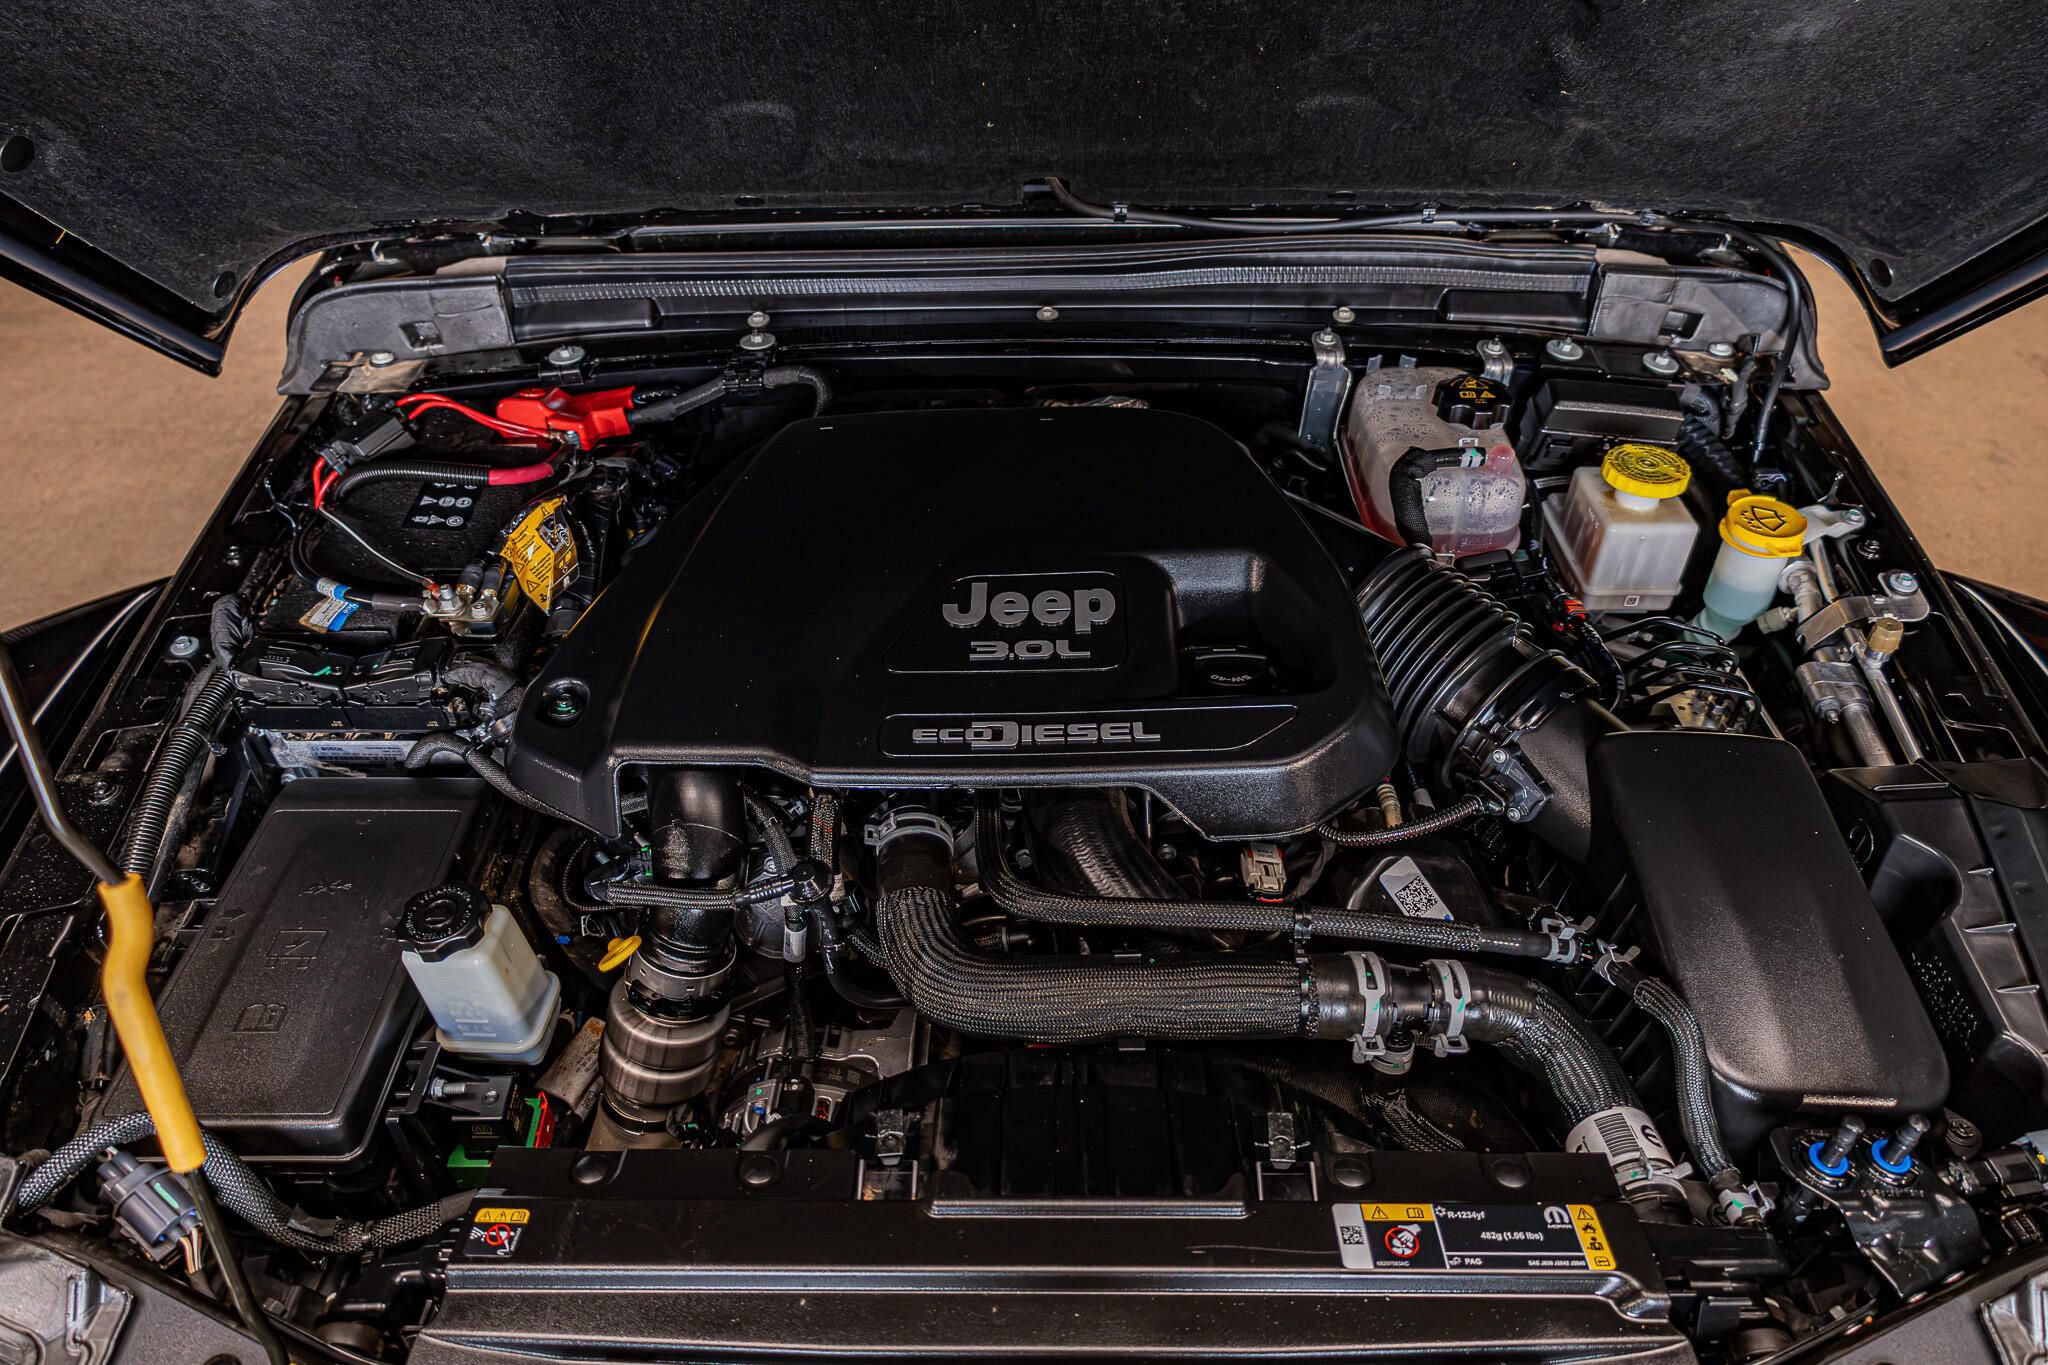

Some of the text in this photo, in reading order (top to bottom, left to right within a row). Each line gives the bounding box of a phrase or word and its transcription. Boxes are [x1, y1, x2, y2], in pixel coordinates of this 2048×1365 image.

[942, 582, 1116, 634] Jeep
[969, 639, 1091, 661] 3.0L
[1447, 1210, 1485, 1221] R-1234yf
[1503, 1231, 1525, 1241] (1.06
[1526, 1231, 1544, 1242] lbs)
[1464, 1257, 1482, 1265] PAG
